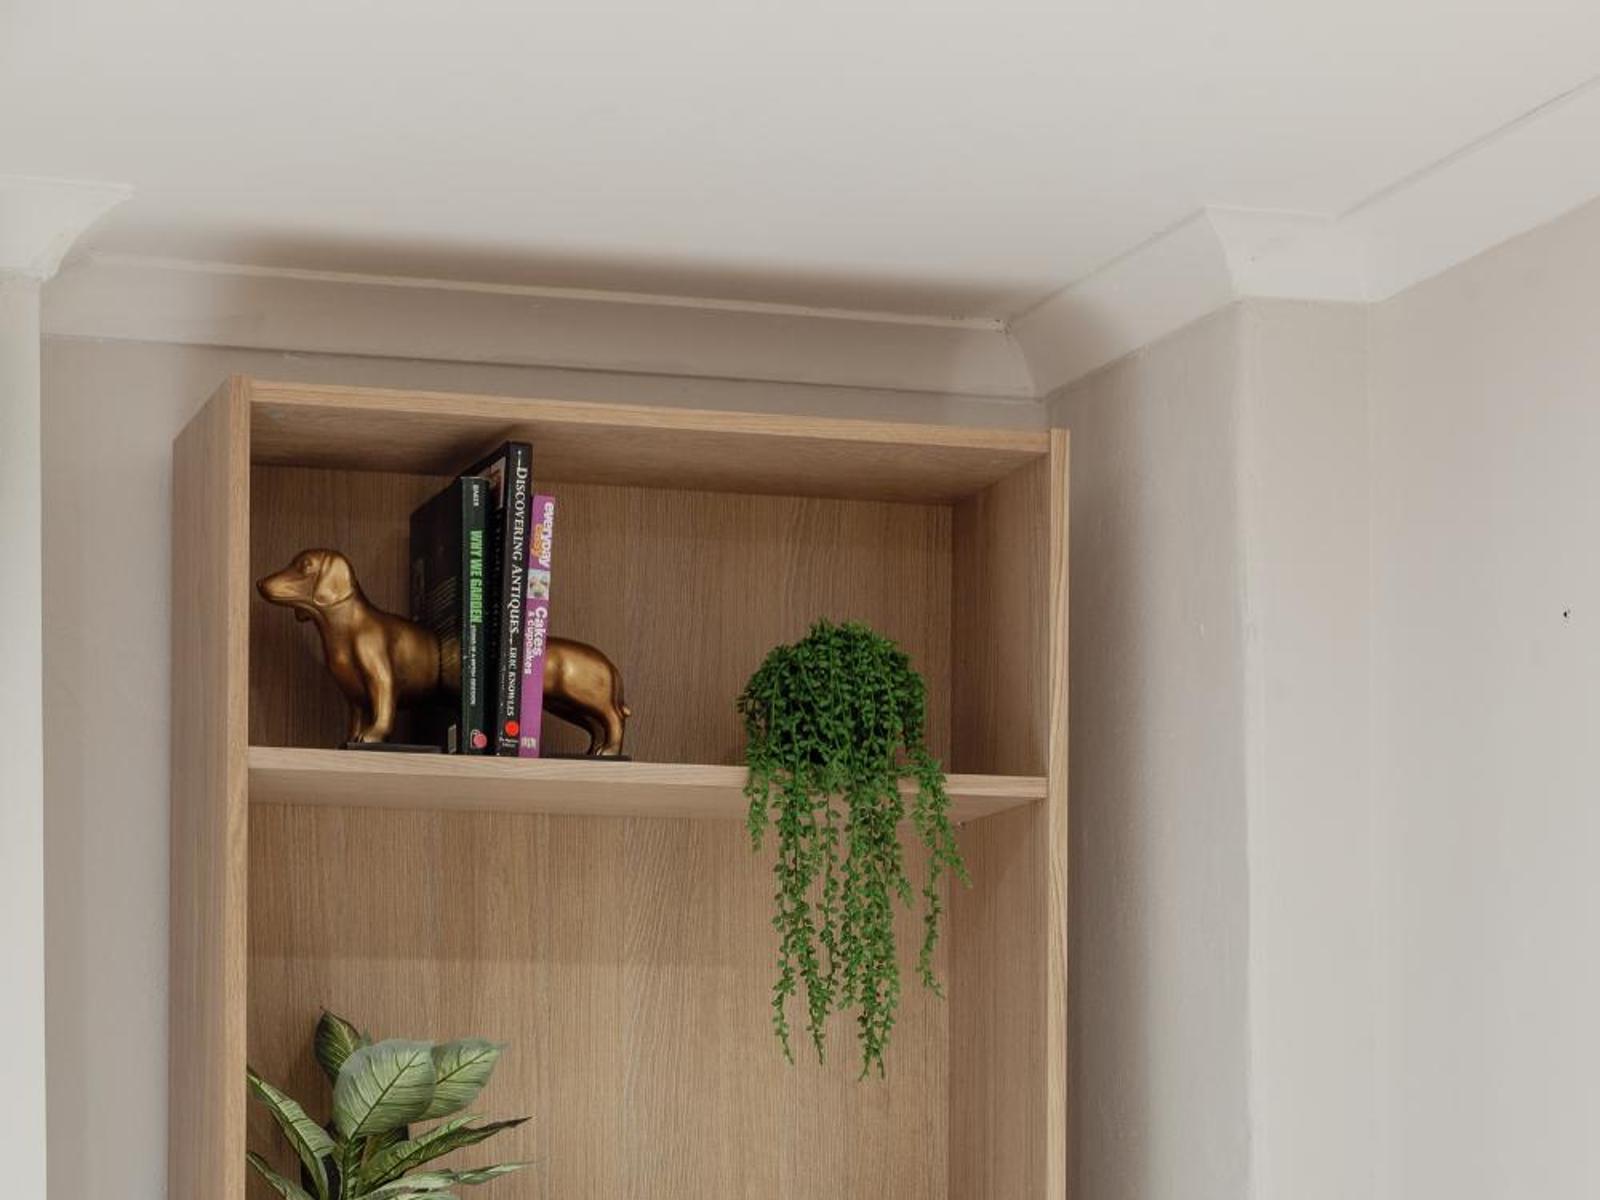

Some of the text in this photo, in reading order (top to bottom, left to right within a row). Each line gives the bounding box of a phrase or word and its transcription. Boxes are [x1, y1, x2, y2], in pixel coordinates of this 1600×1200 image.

[469, 530, 483, 556] WHY
[507, 467, 528, 634] DISCOVERING ANTIQUES
[538, 502, 555, 568] everyday
[469, 559, 483, 577] WE
[469, 579, 483, 623] GARDEN
[524, 619, 535, 674] cupcakes
[533, 607, 548, 656] Cakes
[506, 647, 518, 717] ERIC KNOWLES
